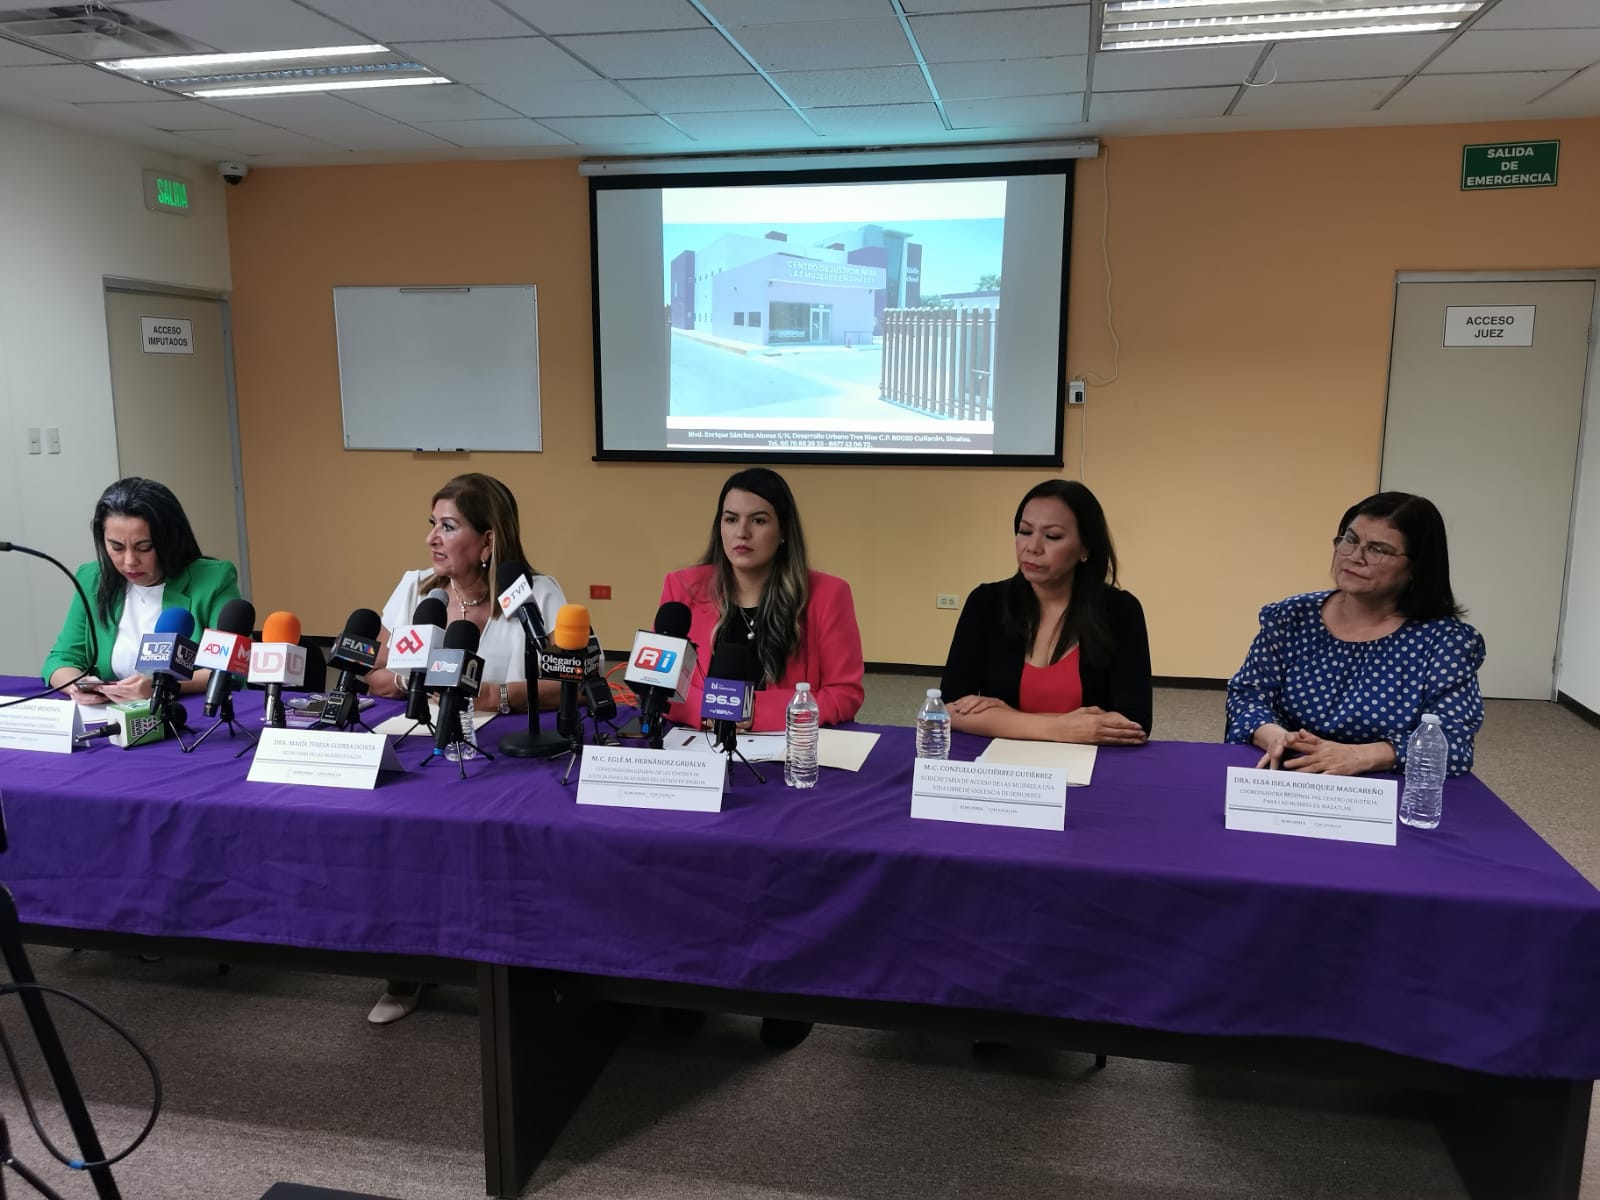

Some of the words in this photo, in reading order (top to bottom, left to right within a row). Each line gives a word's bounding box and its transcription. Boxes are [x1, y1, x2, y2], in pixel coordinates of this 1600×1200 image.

[1487, 147, 1534, 158] SALIDA
[1501, 161, 1518, 171] DE
[1467, 172, 1552, 186] EMERGENCIA
[157, 178, 188, 208] SALIDA
[1466, 316, 1515, 326] ACCESO
[153, 325, 181, 335] ACCESO
[1474, 329, 1504, 339] JUEZ
[148, 337, 188, 347] IMPUTADOS
[510, 582, 526, 600] TVP
[203, 643, 230, 657] ADN
[542, 654, 581, 666] Olegario
[705, 693, 741, 706] 96.9
[940, 765, 976, 775] CONZUELO
[977, 767, 1015, 777] GUTIÉRREZ
[1015, 770, 1053, 780] GUTIÉRREZ
[1253, 778, 1270, 786] ELSA
[1271, 780, 1291, 788] ISELA
[1336, 785, 1383, 796] MASCAREÑO
